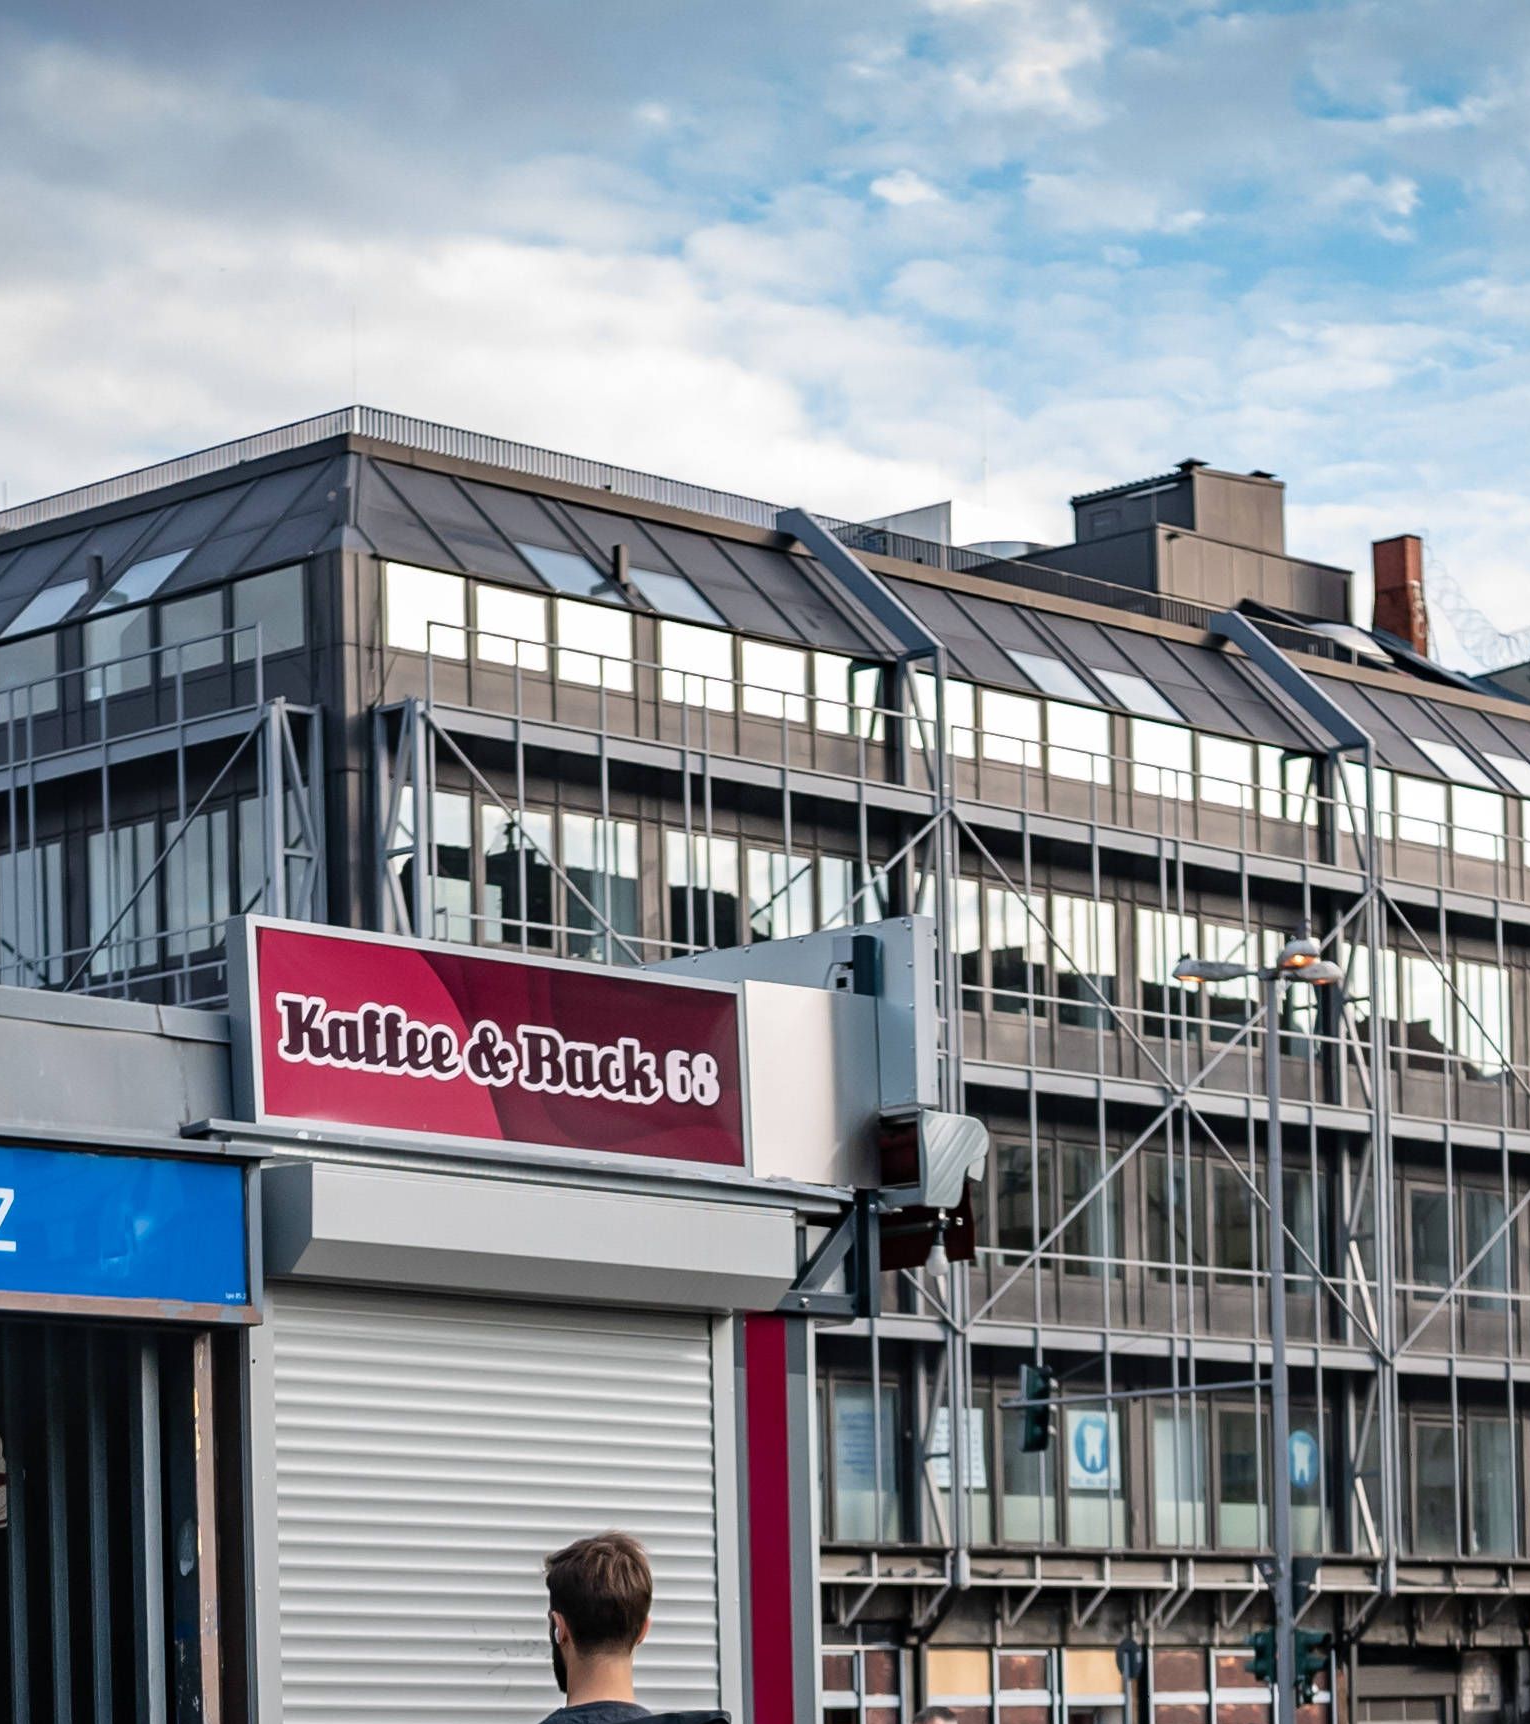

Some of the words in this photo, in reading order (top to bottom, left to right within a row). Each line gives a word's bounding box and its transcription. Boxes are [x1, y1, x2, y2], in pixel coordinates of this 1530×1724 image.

[276, 992, 464, 1079] Kaffee
[463, 1019, 518, 1087] &
[518, 1025, 664, 1105] Back
[665, 1049, 720, 1106] 68
